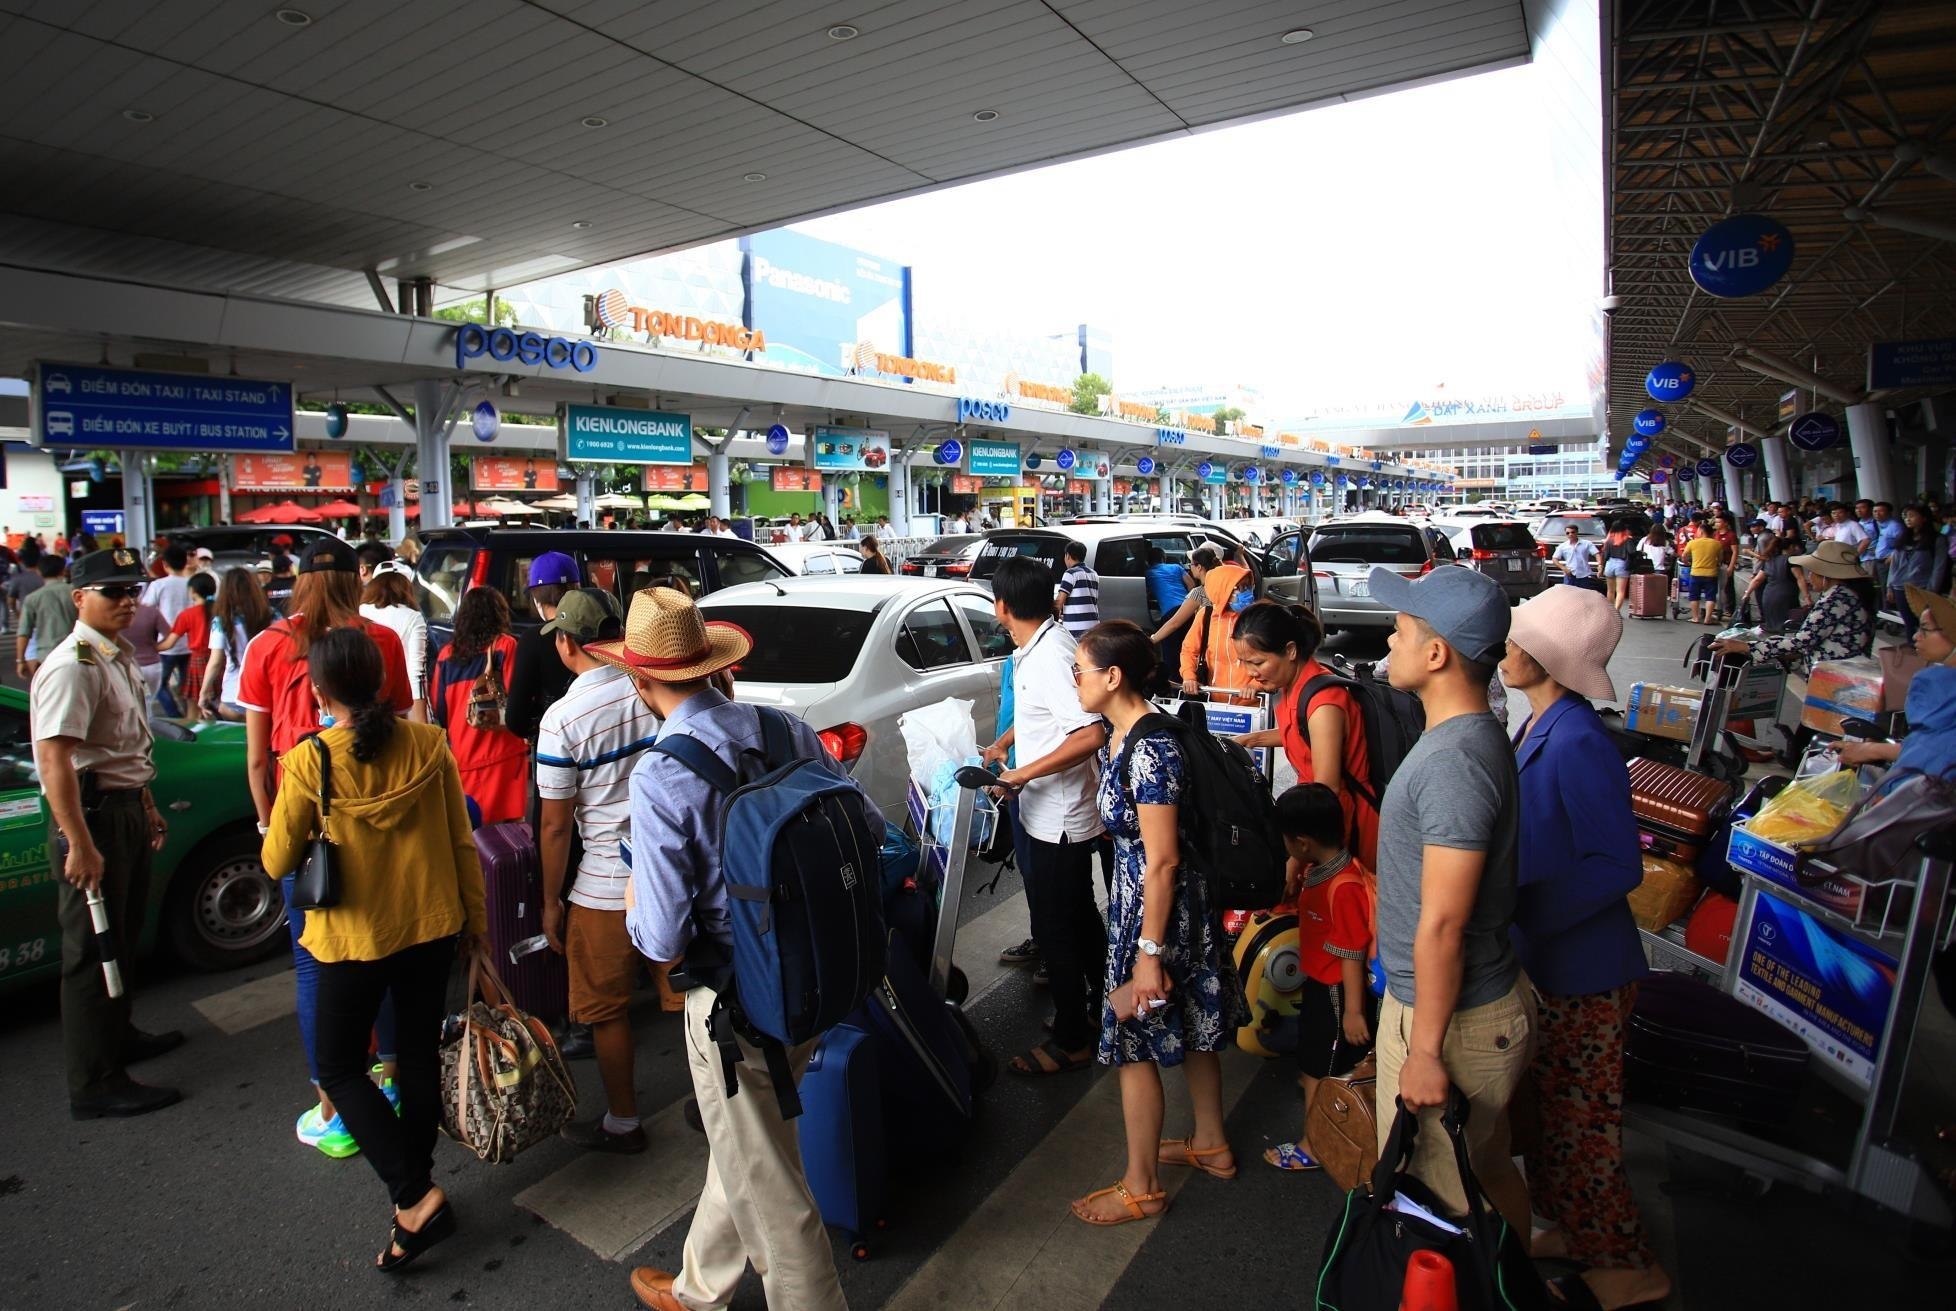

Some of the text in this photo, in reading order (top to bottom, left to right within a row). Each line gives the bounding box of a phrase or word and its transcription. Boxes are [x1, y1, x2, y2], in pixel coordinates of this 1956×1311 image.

[1703, 248, 1760, 272] VIB
[755, 256, 852, 304] Panasonic
[456, 322, 598, 373] posco
[121, 380, 150, 397] ĐÓN
[154, 384, 184, 399] TAXI
[194, 387, 222, 401] TAXI
[226, 389, 265, 404] STAND
[1652, 377, 1680, 389] VIB
[1512, 397, 1566, 412] GROUP
[116, 418, 141, 434] ĐÓN
[144, 421, 160, 435] XE
[200, 424, 222, 438] BUS
[225, 424, 268, 440] STATION
[576, 416, 684, 437] KIENLONGBANK
[1637, 419, 1656, 427] VIB
[15, 938, 46, 966] 38
[1752, 951, 1821, 1000] ONE OF THE LEADING
[1751, 962, 1875, 1048] TEXTILE AND GARMENT MANUFACTURERS
